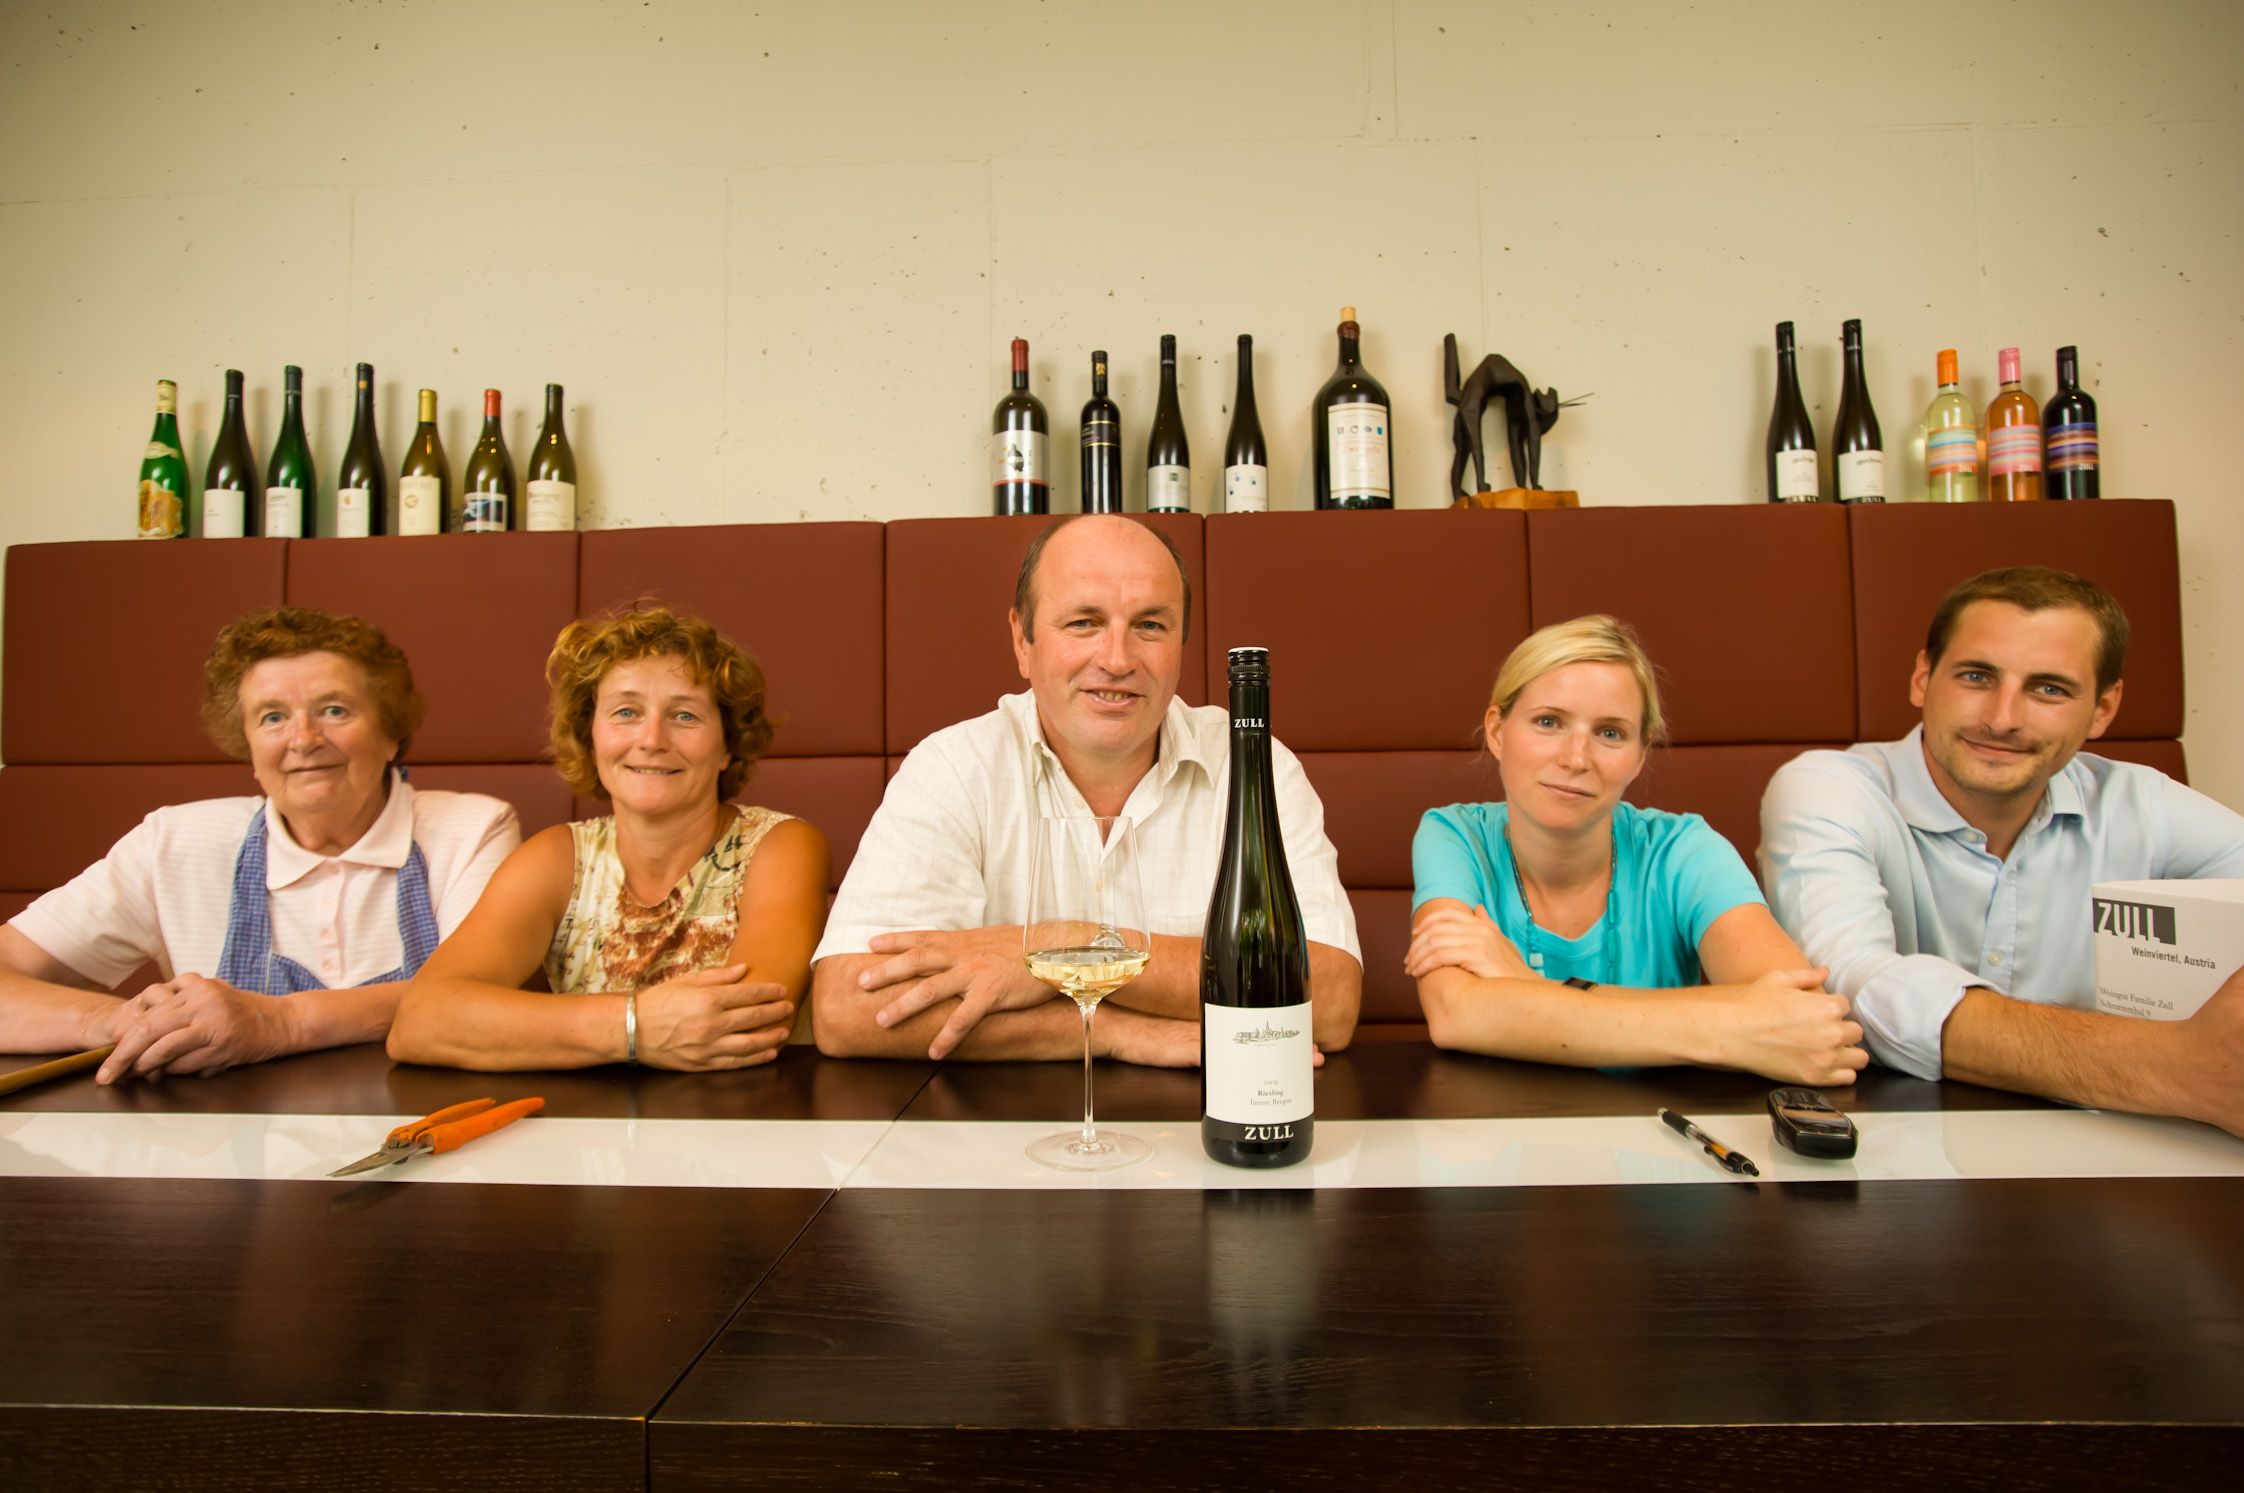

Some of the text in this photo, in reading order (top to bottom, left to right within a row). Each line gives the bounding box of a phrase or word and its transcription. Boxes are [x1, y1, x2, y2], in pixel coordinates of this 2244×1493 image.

[1234, 718, 1265, 729] ZULL
[2097, 902, 2161, 942] ZULL
[2131, 946, 2216, 970] Weinviertel, Austria
[2130, 993, 2156, 1006] Familie
[2157, 999, 2174, 1011] Zull
[1244, 1125, 1294, 1140] ZULL
